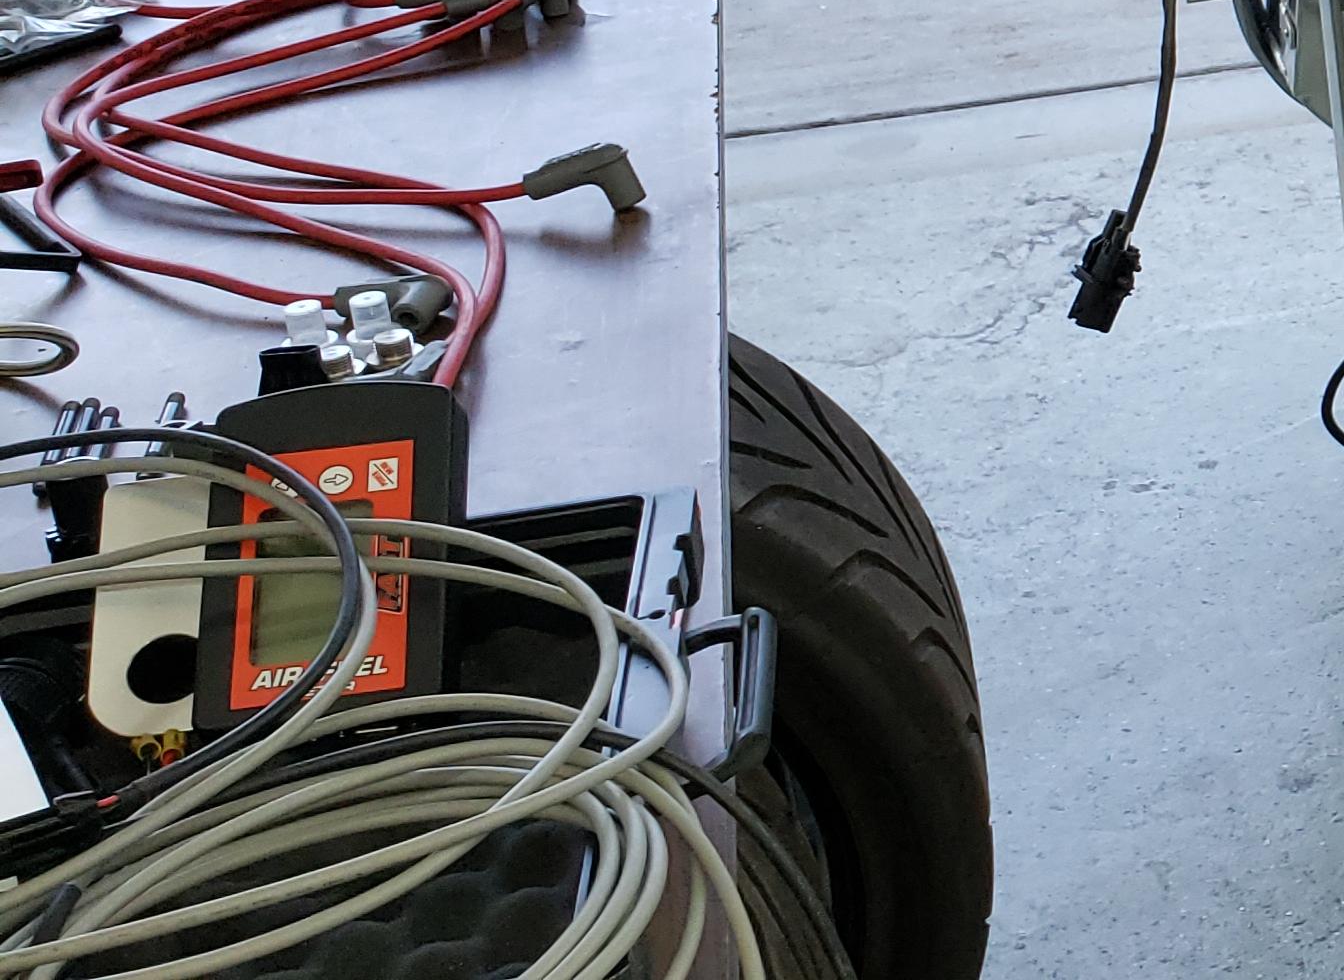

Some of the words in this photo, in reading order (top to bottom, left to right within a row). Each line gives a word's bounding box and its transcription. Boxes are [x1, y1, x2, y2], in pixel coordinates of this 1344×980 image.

[377, 534, 403, 610] FAT
[250, 666, 304, 691] AIR
[319, 655, 388, 682] FEL
